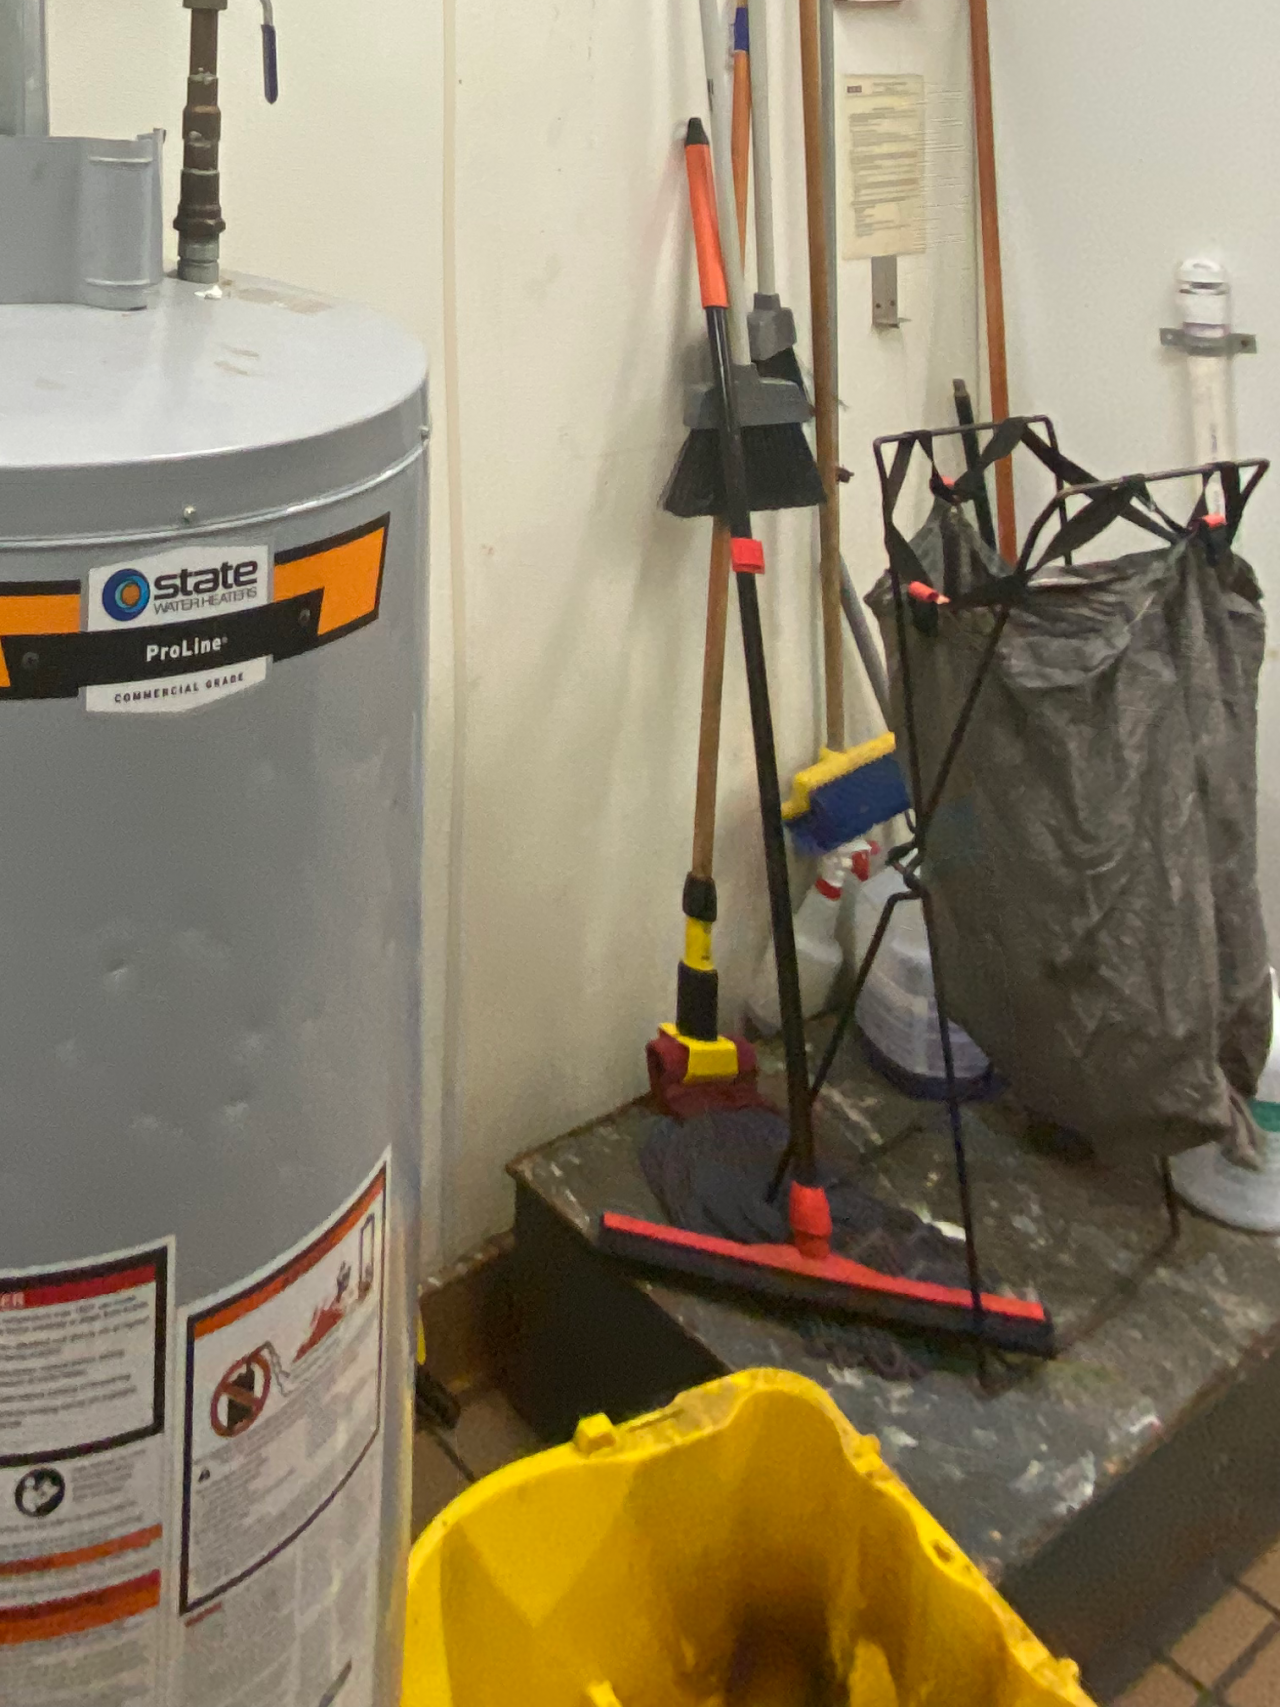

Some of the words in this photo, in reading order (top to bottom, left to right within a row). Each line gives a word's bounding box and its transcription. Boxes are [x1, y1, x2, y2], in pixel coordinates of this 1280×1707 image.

[154, 560, 258, 600] state
[153, 597, 199, 615] WATER
[201, 586, 258, 609] HEATERS
[114, 682, 200, 704] COMMERCIAL
[205, 672, 244, 689] GRADE
